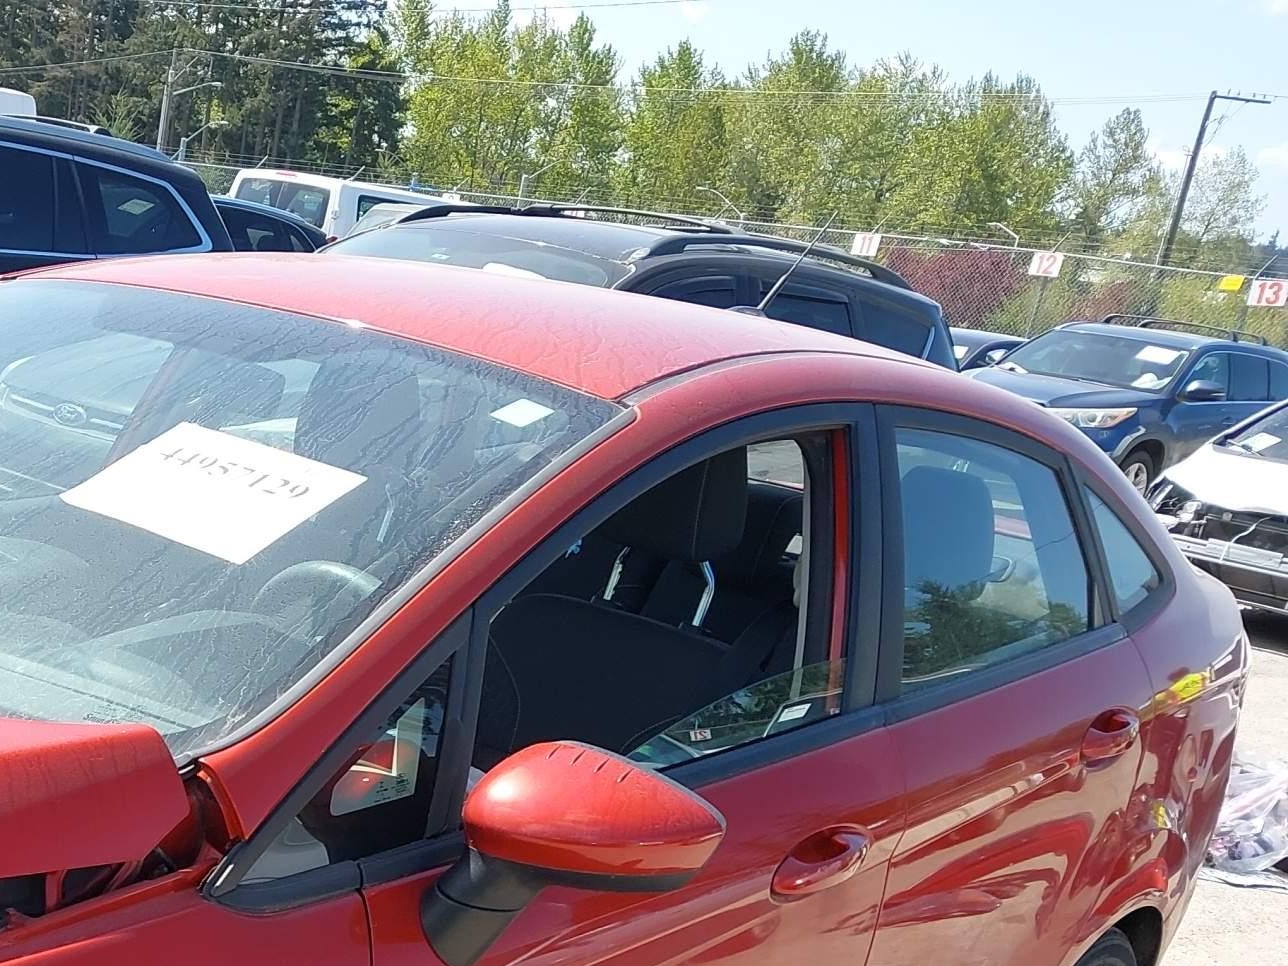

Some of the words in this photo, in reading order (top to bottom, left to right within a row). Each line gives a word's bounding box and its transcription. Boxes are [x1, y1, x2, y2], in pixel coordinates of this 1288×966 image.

[858, 234, 875, 255] 11
[1035, 253, 1058, 275] 12
[1255, 281, 1284, 305] 13
[159, 447, 311, 499] 44957129
